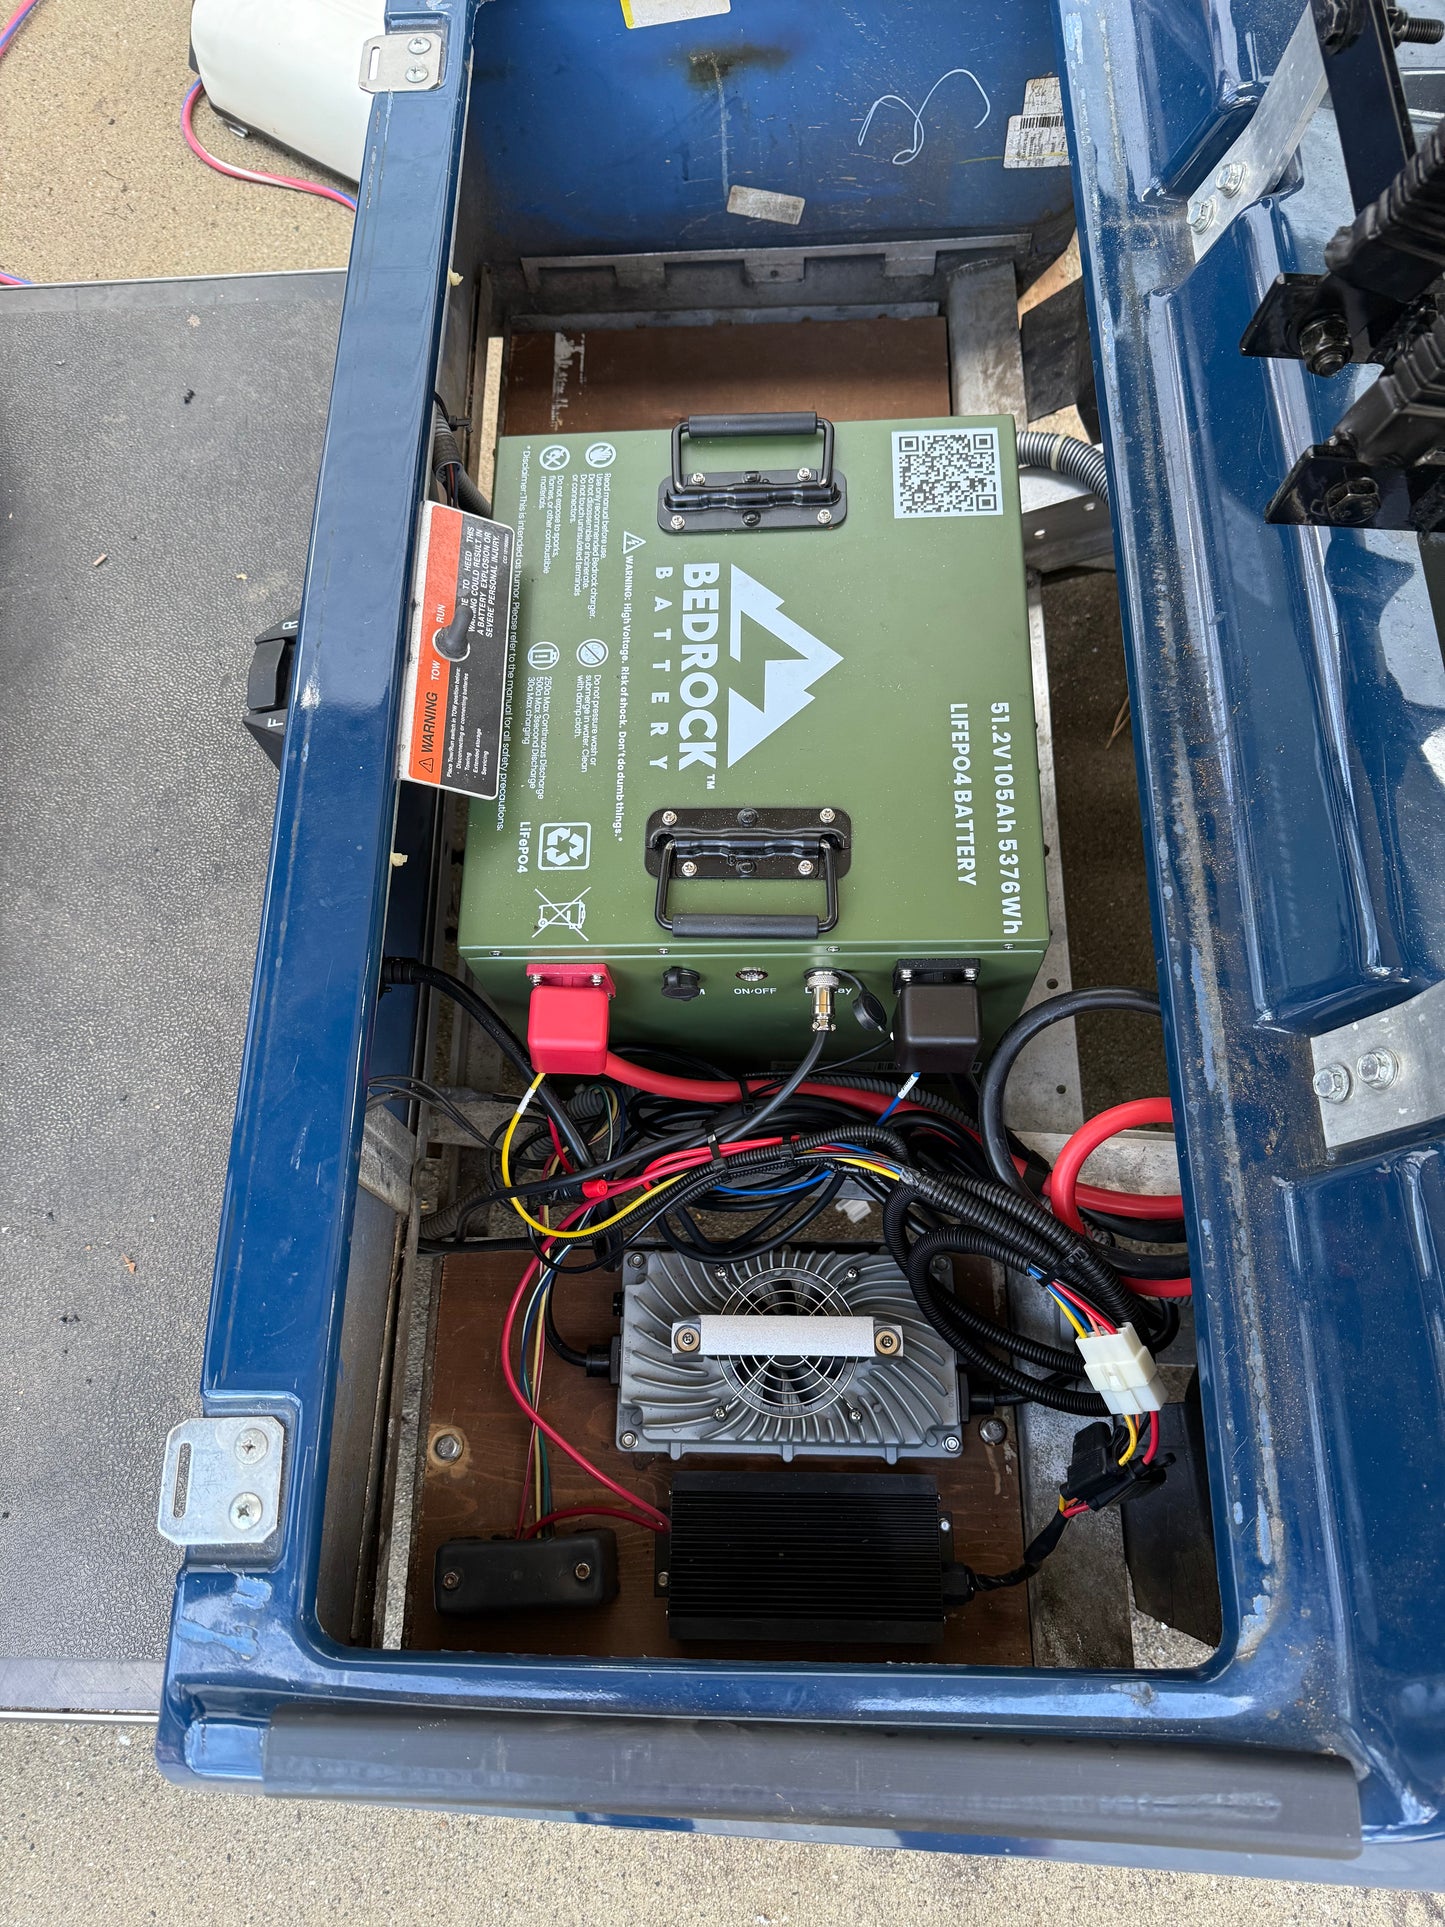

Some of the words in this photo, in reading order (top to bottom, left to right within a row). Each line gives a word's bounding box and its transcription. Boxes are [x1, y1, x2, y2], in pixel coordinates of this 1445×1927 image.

[557, 475, 564, 484] Do
[580, 474, 587, 484] Do
[588, 474, 595, 483] Do
[570, 483, 578, 524] connectors.
[594, 487, 602, 502] only
[554, 498, 562, 523] expose
[586, 497, 594, 541] disassemble
[466, 526, 474, 542] THIS
[476, 529, 483, 537] IN
[484, 532, 491, 543] OR
[516, 520, 526, 557] intended
[552, 533, 560, 557] sparks,
[576, 519, 584, 560] uninsulated
[601, 521, 609, 543] before
[464, 551, 472, 571] HEED
[474, 539, 482, 567] RESULT
[492, 535, 500, 562] INJURY.
[543, 530, 552, 574] combustible
[481, 545, 490, 588] EXPLOSION
[515, 559, 522, 569] as
[583, 552, 591, 589] incinerate.
[591, 557, 599, 587] Bedrock
[462, 579, 470, 589] TO
[471, 570, 479, 596] COULD
[488, 565, 498, 605] PERSONAL
[513, 571, 522, 601] humor.
[574, 562, 583, 596] terminals
[624, 556, 633, 600] WARNING:
[437, 604, 445, 623] RUN
[478, 591, 487, 627] BATTERY
[511, 602, 520, 630] Please
[588, 588, 598, 619] charger.
[621, 603, 632, 624] High
[282, 620, 298, 630] R
[486, 607, 495, 638] SEVERE
[509, 632, 517, 652] refer
[620, 625, 630, 663] Voltage.
[431, 660, 441, 681] TOW
[508, 653, 516, 662] to
[650, 566, 673, 770] BATTERY
[679, 562, 719, 771] BEDROCK
[507, 664, 516, 678] the
[527, 677, 535, 691] 30a
[594, 675, 601, 685] Do
[621, 667, 629, 685] Risk
[505, 680, 514, 715] manual
[535, 676, 543, 696] 500a
[544, 676, 552, 695] 250a
[582, 675, 592, 714] submerge
[621, 687, 629, 696] of
[460, 696, 468, 724] connecting
[526, 693, 534, 708] Max
[534, 698, 542, 713] Max
[542, 697, 550, 712] Max
[574, 692, 583, 716] damp
[619, 698, 628, 728] shock.
[267, 718, 284, 728] F
[421, 692, 438, 753] WARNING
[504, 717, 512, 729] for
[522, 710, 533, 744] charging
[574, 717, 582, 738] cloth.
[591, 700, 599, 734] pressure
[503, 731, 511, 741] all
[532, 715, 541, 748] 3second
[540, 714, 549, 758] Continuous
[582, 724, 590, 748] water.
[990, 702, 1011, 759] 51.2V
[456, 732, 465, 769] Disconnecting
[590, 735, 598, 756] wash
[950, 703, 972, 785] LIFEPO4
[464, 752, 472, 771] Towing
[481, 751, 489, 775] Servicing
[499, 743, 510, 772] safety
[528, 749, 539, 789] Discharge
[581, 749, 589, 772] Clean
[590, 758, 597, 766] or
[617, 759, 626, 770] do
[536, 760, 547, 799] Discharge
[616, 772, 625, 801] dumb
[995, 764, 1016, 832] 105Ah
[517, 822, 531, 873] LiFePO4
[954, 790, 976, 886] BATTERY
[998, 839, 1022, 934] 5376Wh
